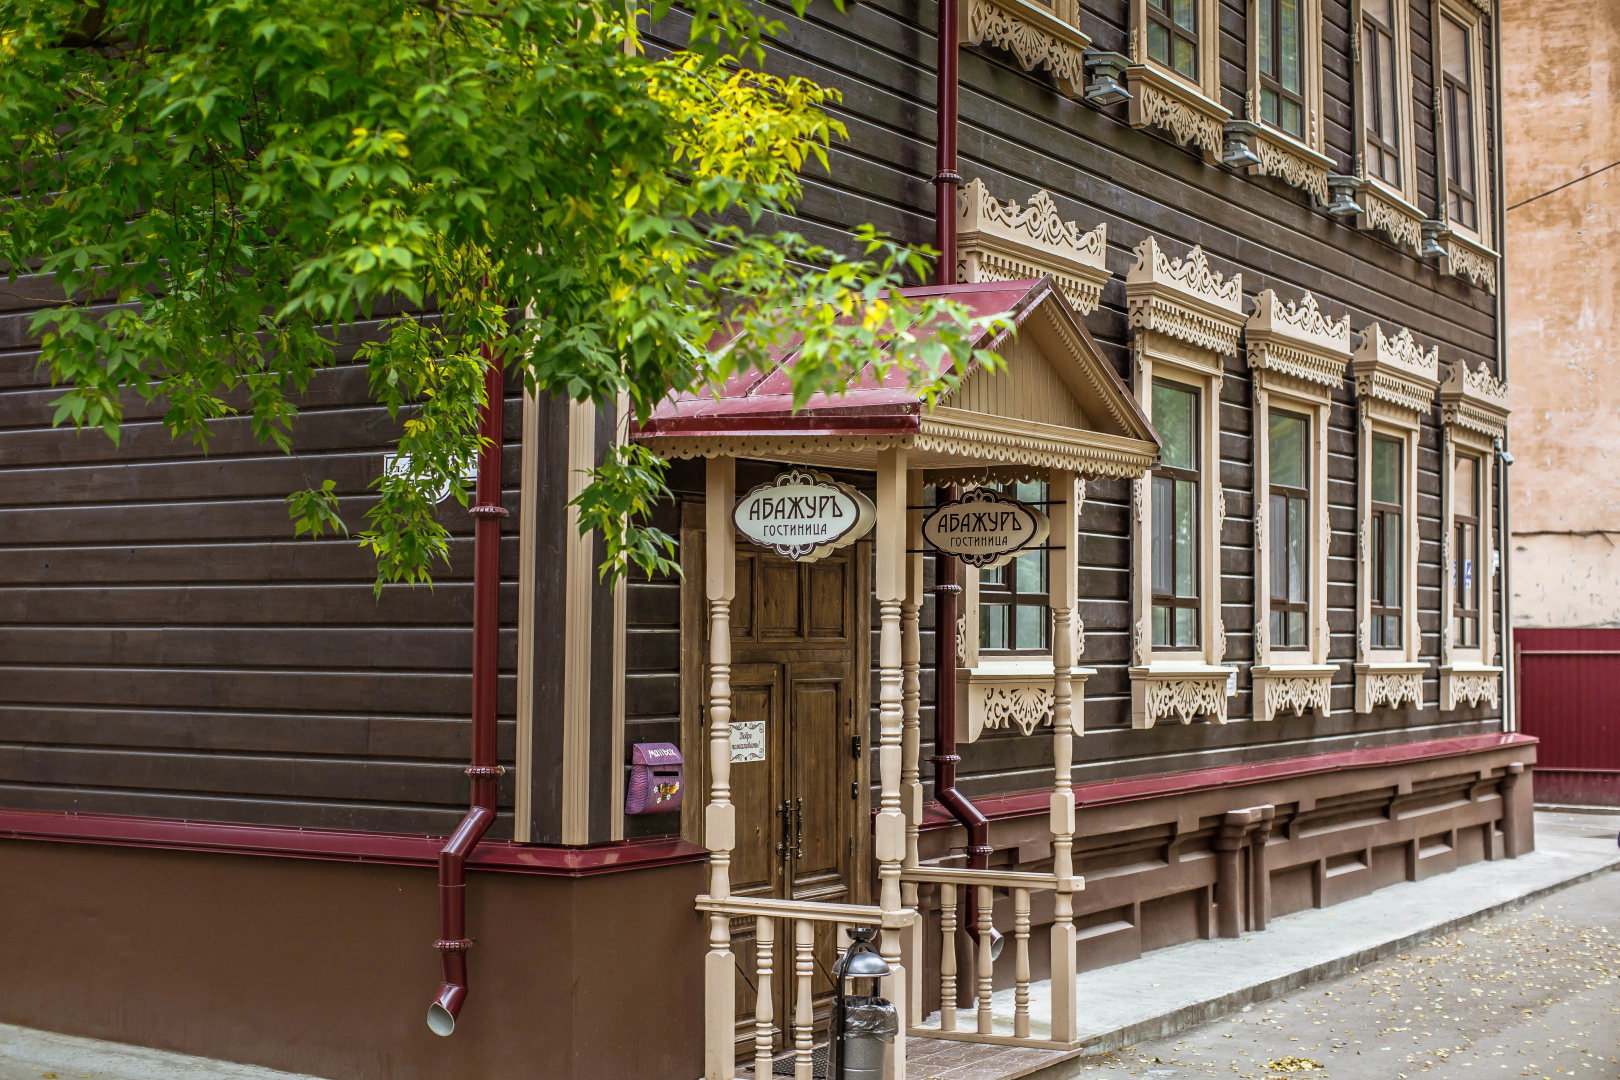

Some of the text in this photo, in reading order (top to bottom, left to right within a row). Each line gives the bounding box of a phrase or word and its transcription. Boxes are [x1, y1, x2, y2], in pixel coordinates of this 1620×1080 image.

[749, 495, 843, 521] АБАЖУРЪ
[763, 523, 827, 537] ГОСТИНИЦА
[938, 511, 1022, 533] АБАЖУРЪ
[950, 535, 1008, 547] ГОСТИНИЦА
